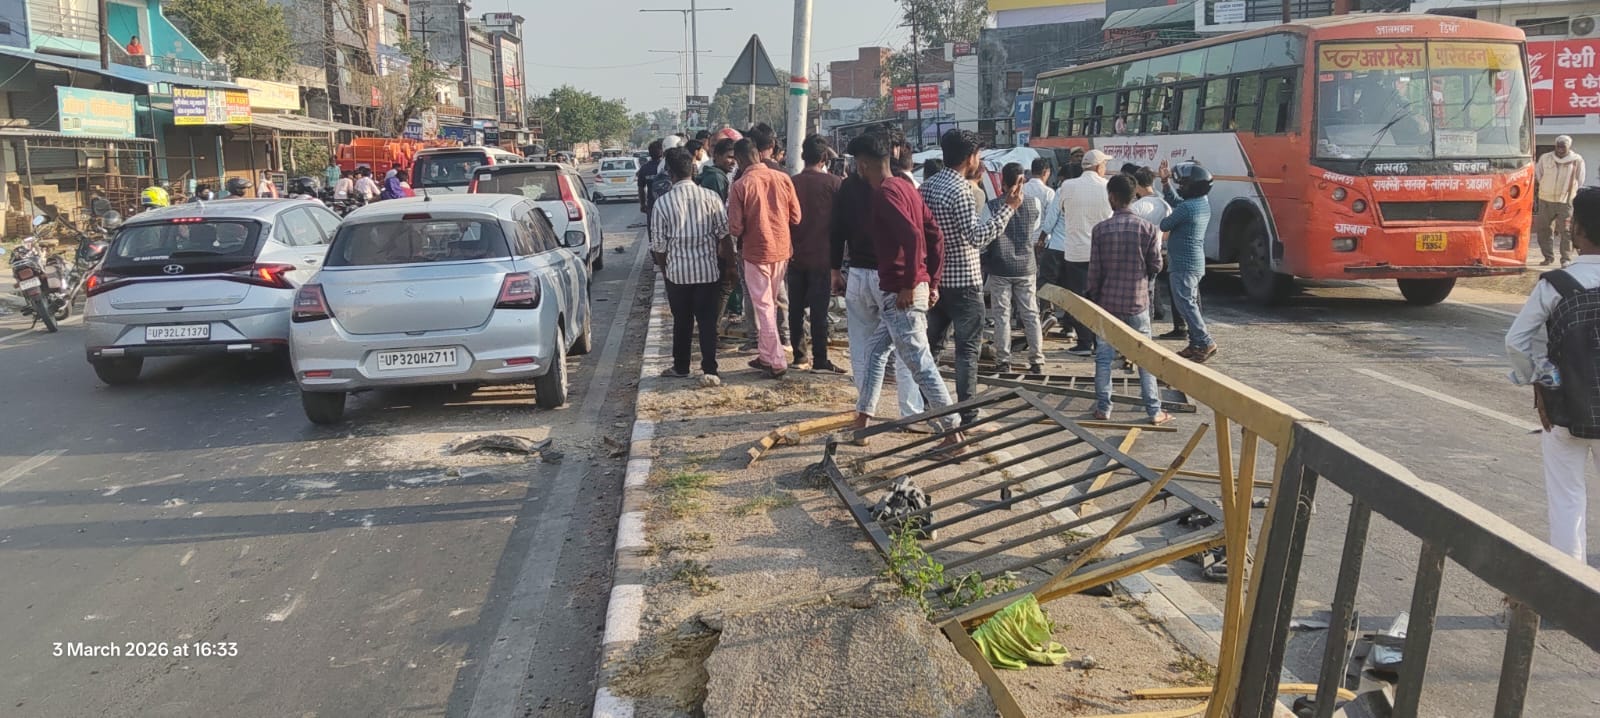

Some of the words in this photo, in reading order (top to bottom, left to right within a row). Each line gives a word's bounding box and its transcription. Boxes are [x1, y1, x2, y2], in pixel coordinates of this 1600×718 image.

[1557, 45, 1597, 68] देशी
[1581, 73, 1600, 90] फै
[151, 325, 209, 338] UP32LZ1370
[385, 350, 456, 366] UP32QH2711
